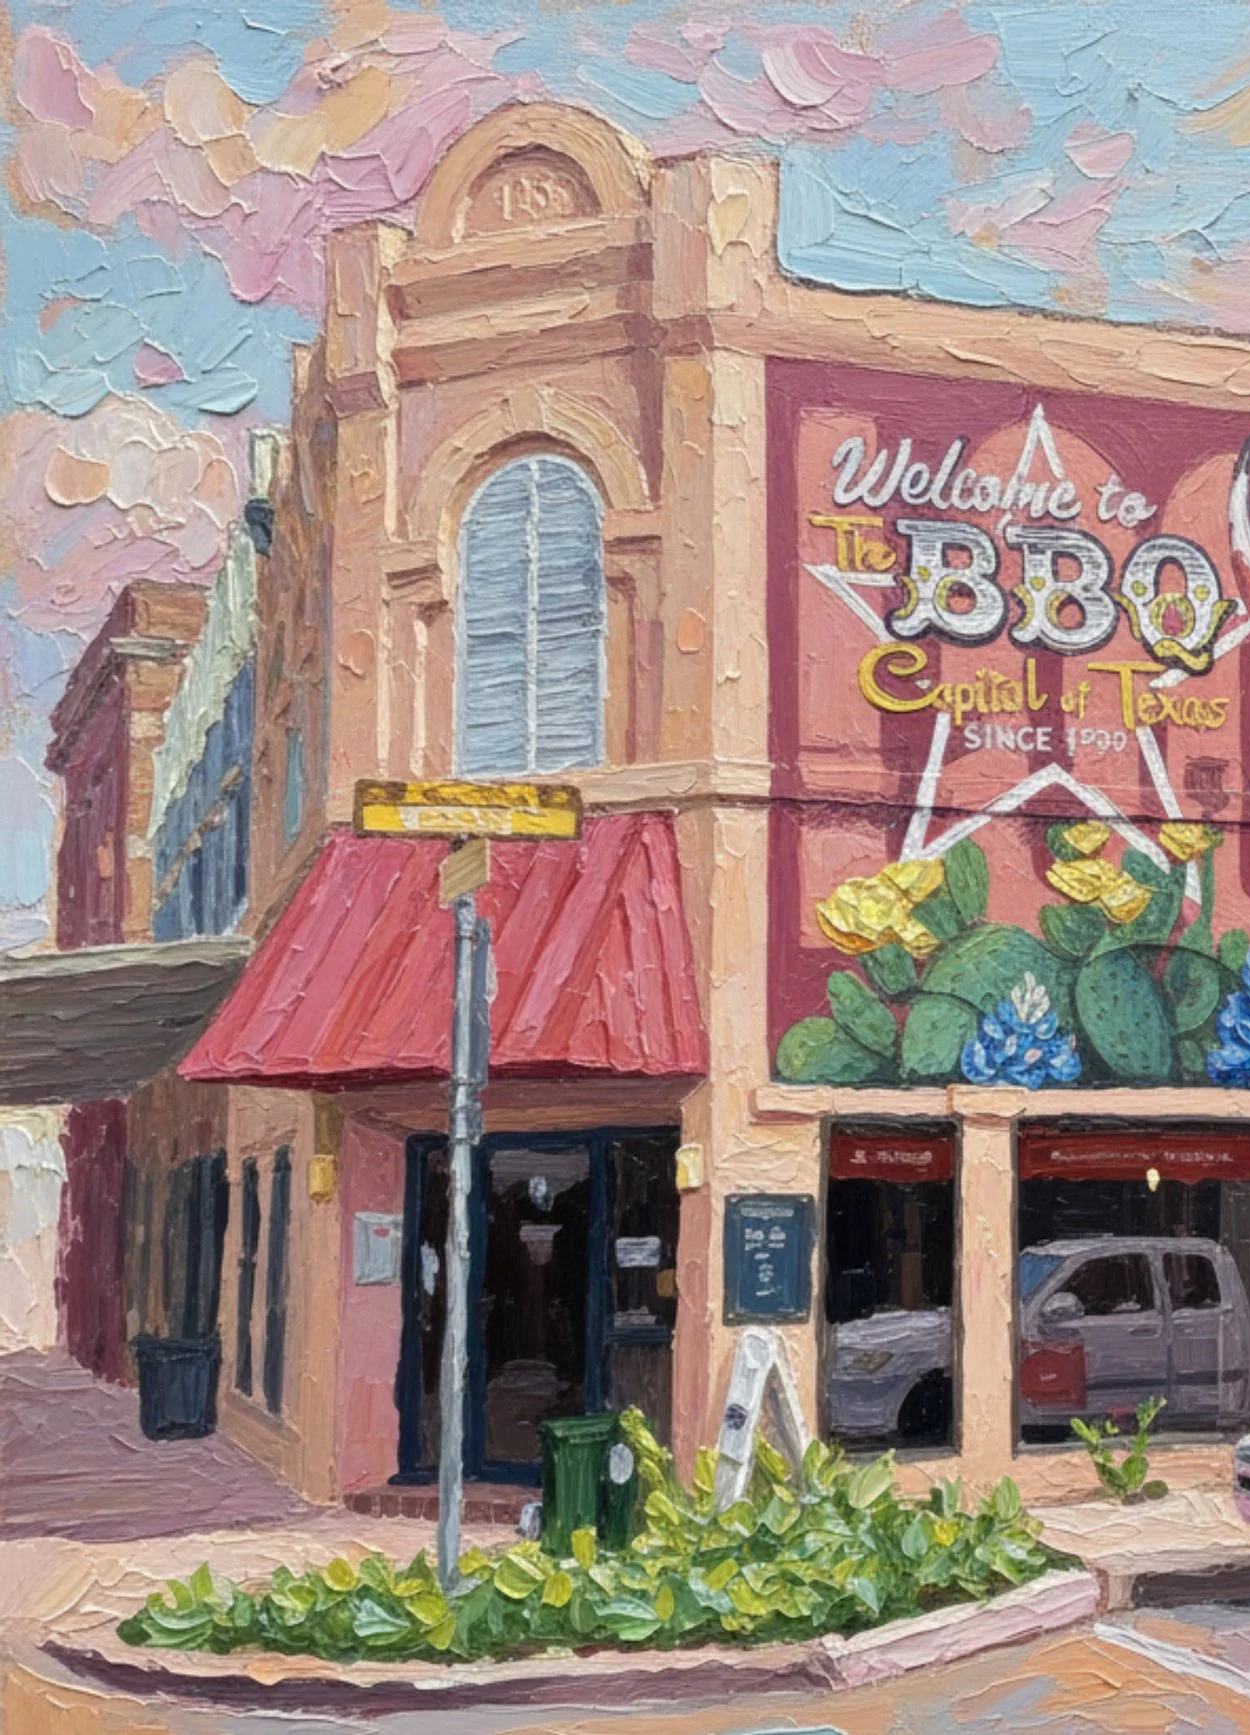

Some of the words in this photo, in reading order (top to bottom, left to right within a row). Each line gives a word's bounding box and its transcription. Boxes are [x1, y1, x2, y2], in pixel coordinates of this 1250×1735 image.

[831, 436, 1082, 520] Welcome
[1096, 474, 1157, 528] to
[809, 514, 898, 572] The
[885, 517, 1238, 677] BBQ
[1060, 681, 1092, 719] of
[1087, 660, 1230, 731] Texas
[964, 723, 1053, 753] SINCE
